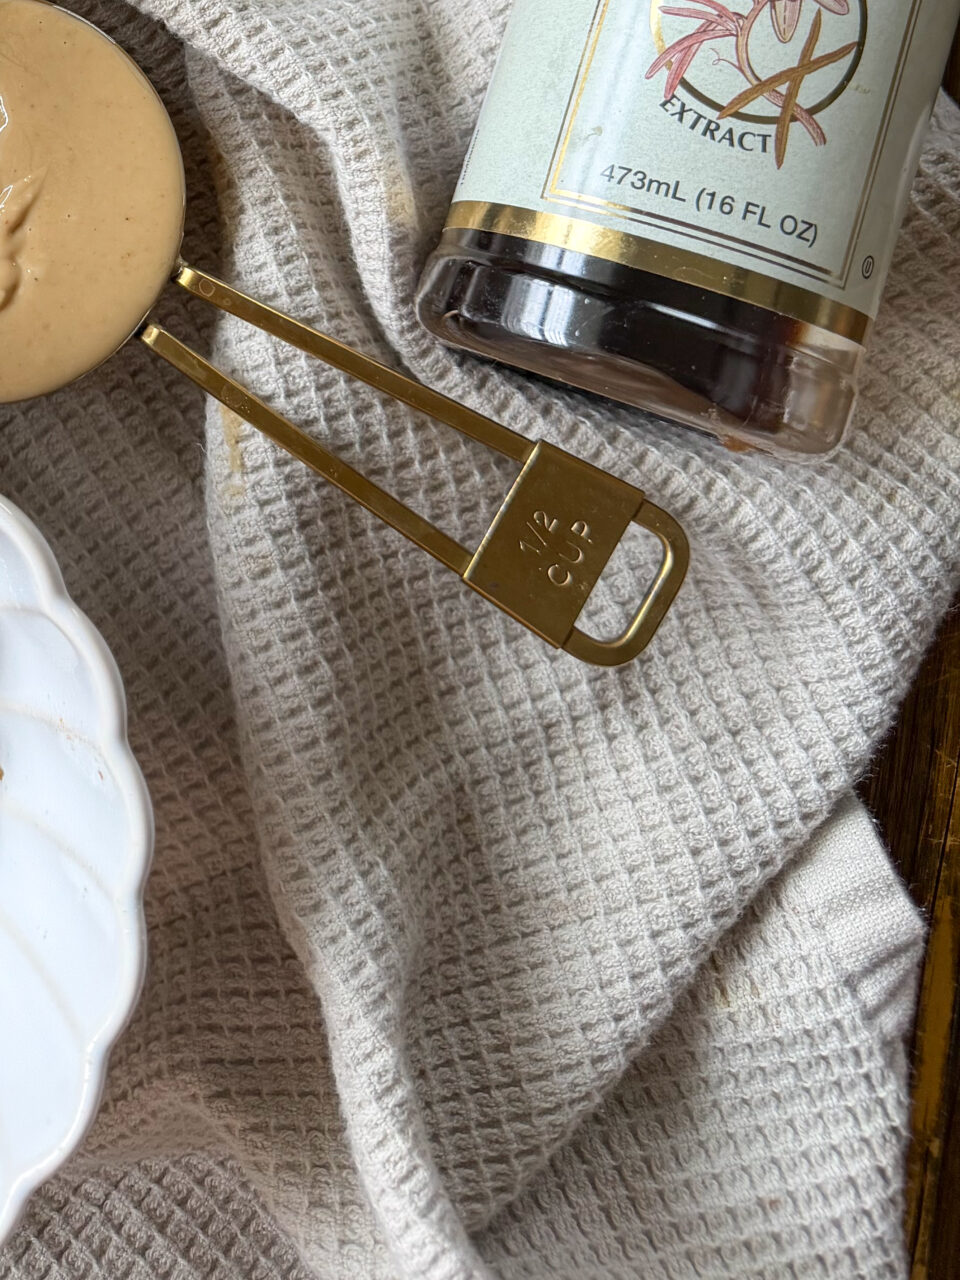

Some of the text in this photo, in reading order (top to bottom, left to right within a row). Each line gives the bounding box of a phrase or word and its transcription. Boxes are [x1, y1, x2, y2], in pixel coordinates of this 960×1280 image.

[658, 93, 772, 154] EXTRACT
[599, 163, 818, 248] 473mL (16 FL OZ)
[520, 510, 559, 554] 1/2
[547, 520, 594, 587] CUP
